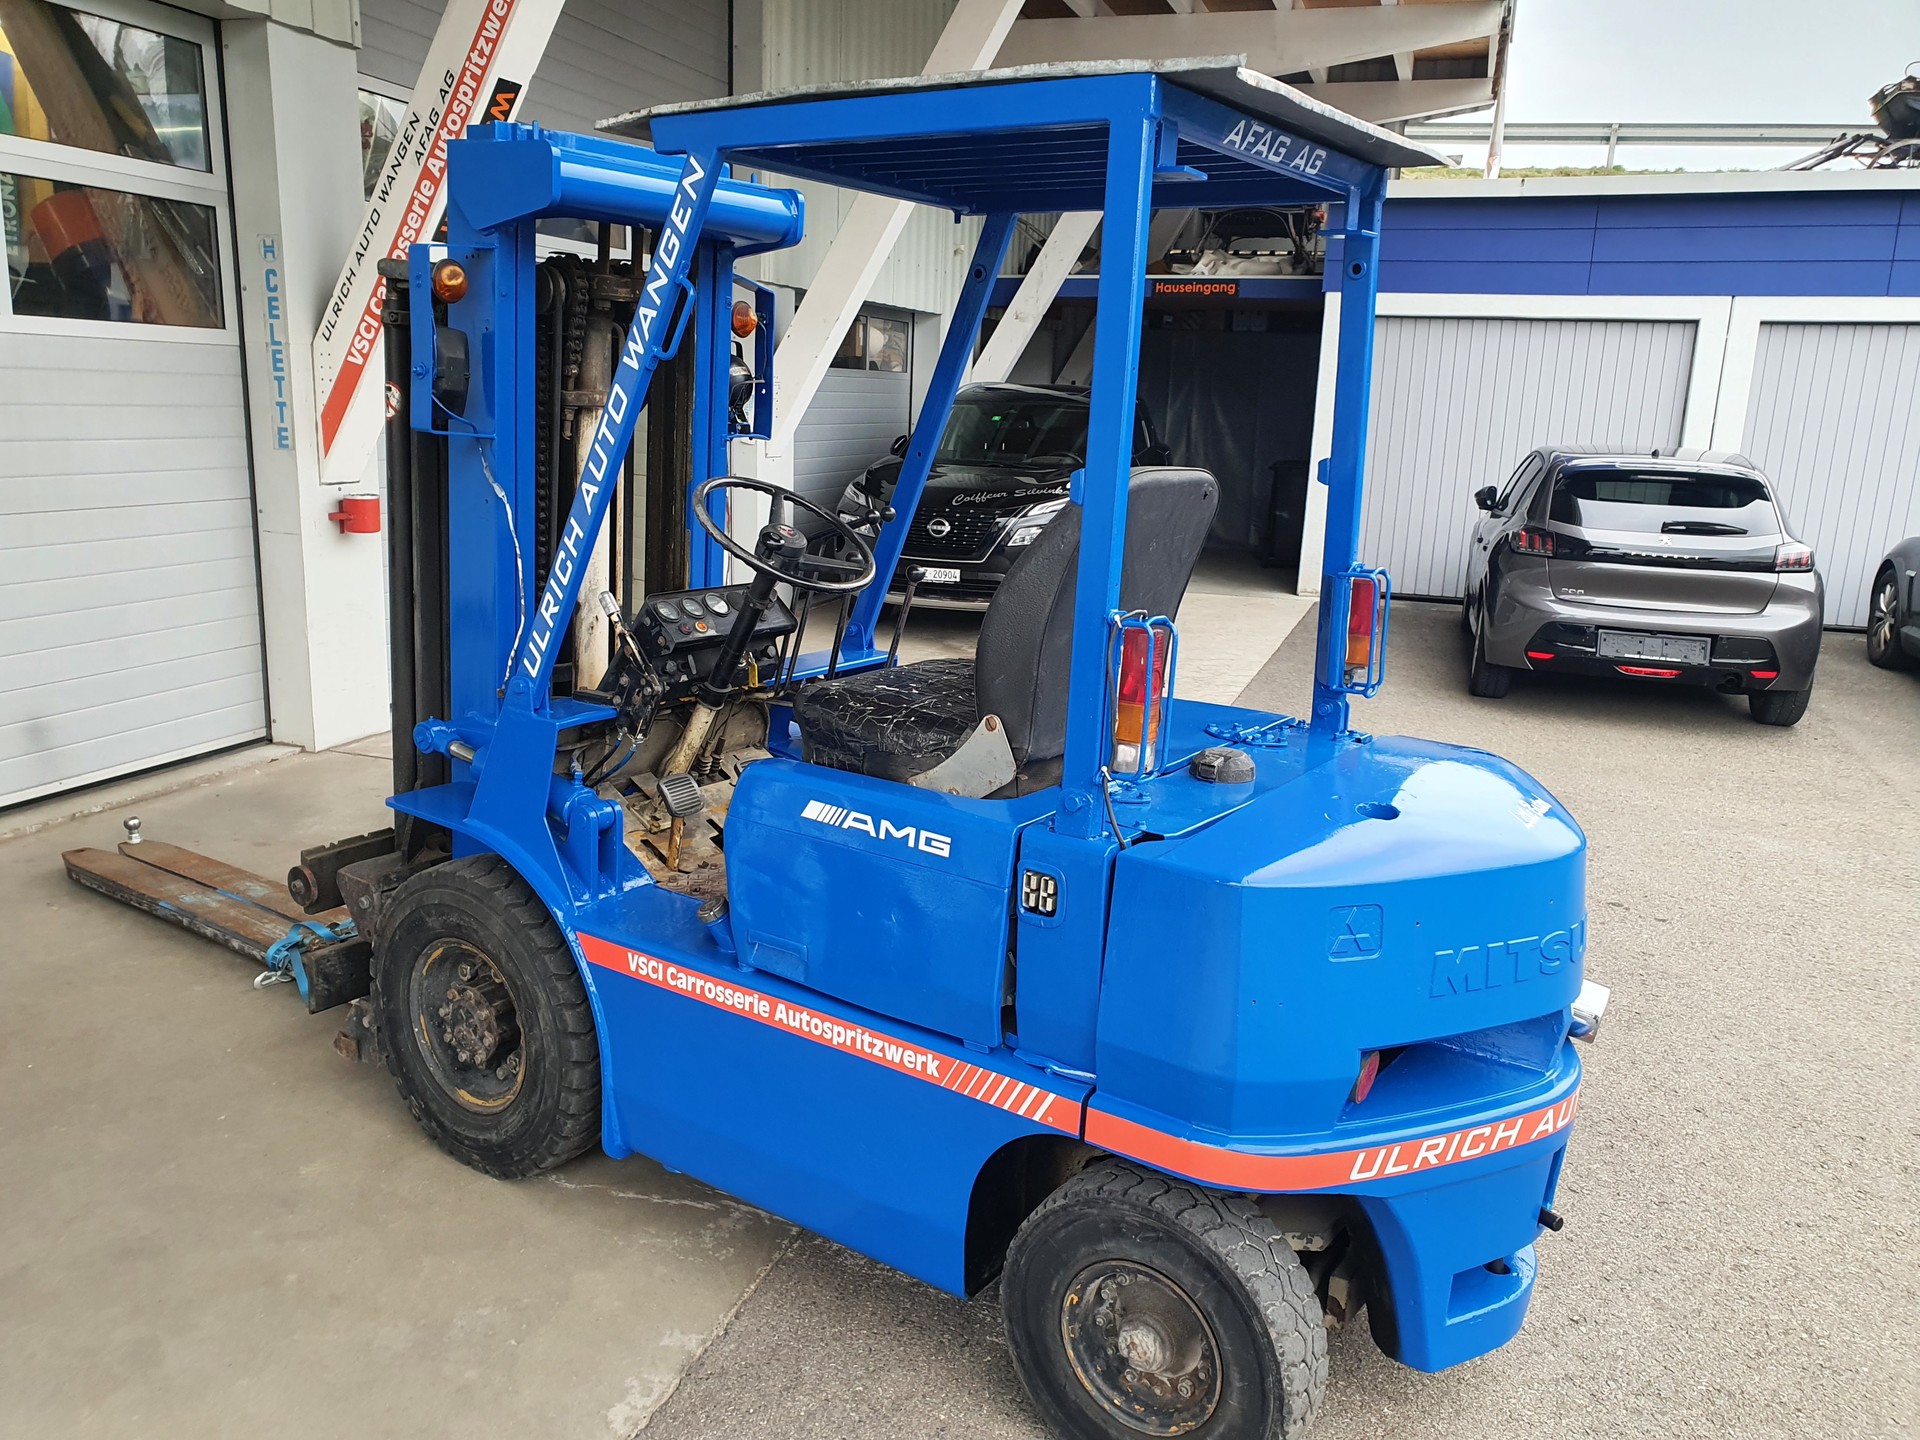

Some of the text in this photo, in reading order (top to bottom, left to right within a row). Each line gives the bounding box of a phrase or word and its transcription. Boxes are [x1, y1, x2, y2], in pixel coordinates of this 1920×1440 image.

[413, 69, 456, 167] AFAG AG
[1222, 119, 1328, 176] AFAG AG
[346, 316, 379, 367] VSCI
[369, 179, 435, 316] Caosserie
[426, 0, 511, 178] Autospritzwe
[321, 111, 421, 342] ULRICH AUTO WANGEN
[1155, 281, 1236, 296] Hauseingang
[522, 155, 705, 679] ULRICH AUTO WANGEN
[952, 492, 1009, 506] Coiffeur
[933, 569, 958, 580] 20904
[838, 813, 952, 858] AMG
[626, 952, 941, 1078] VSCI Carrosserie Autospritzwerk
[1349, 1117, 1525, 1182] ULRICH
